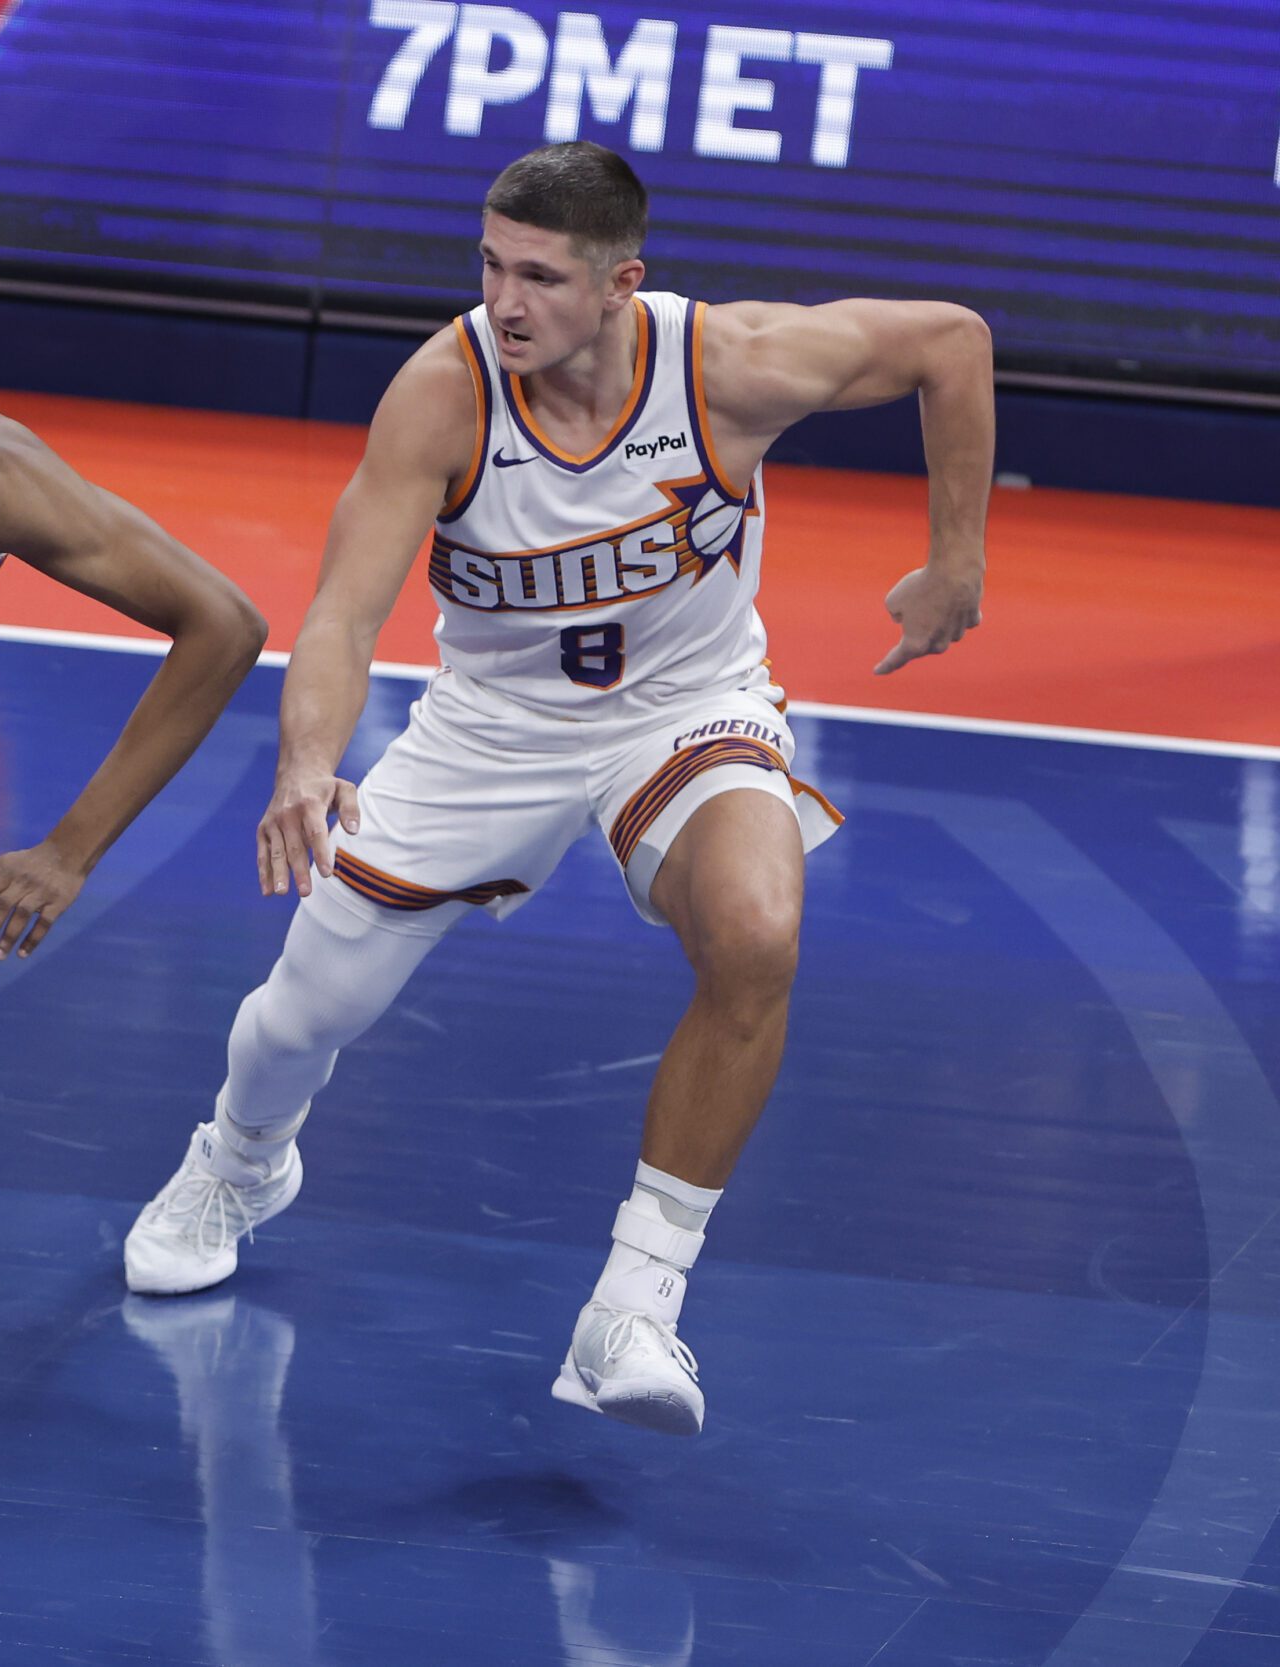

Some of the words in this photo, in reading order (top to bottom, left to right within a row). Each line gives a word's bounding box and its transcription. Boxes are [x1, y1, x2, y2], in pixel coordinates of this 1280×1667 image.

[367, 0, 678, 152] 7PM
[693, 24, 895, 168] ET
[625, 432, 687, 459] PayPal
[560, 622, 626, 691] 8
